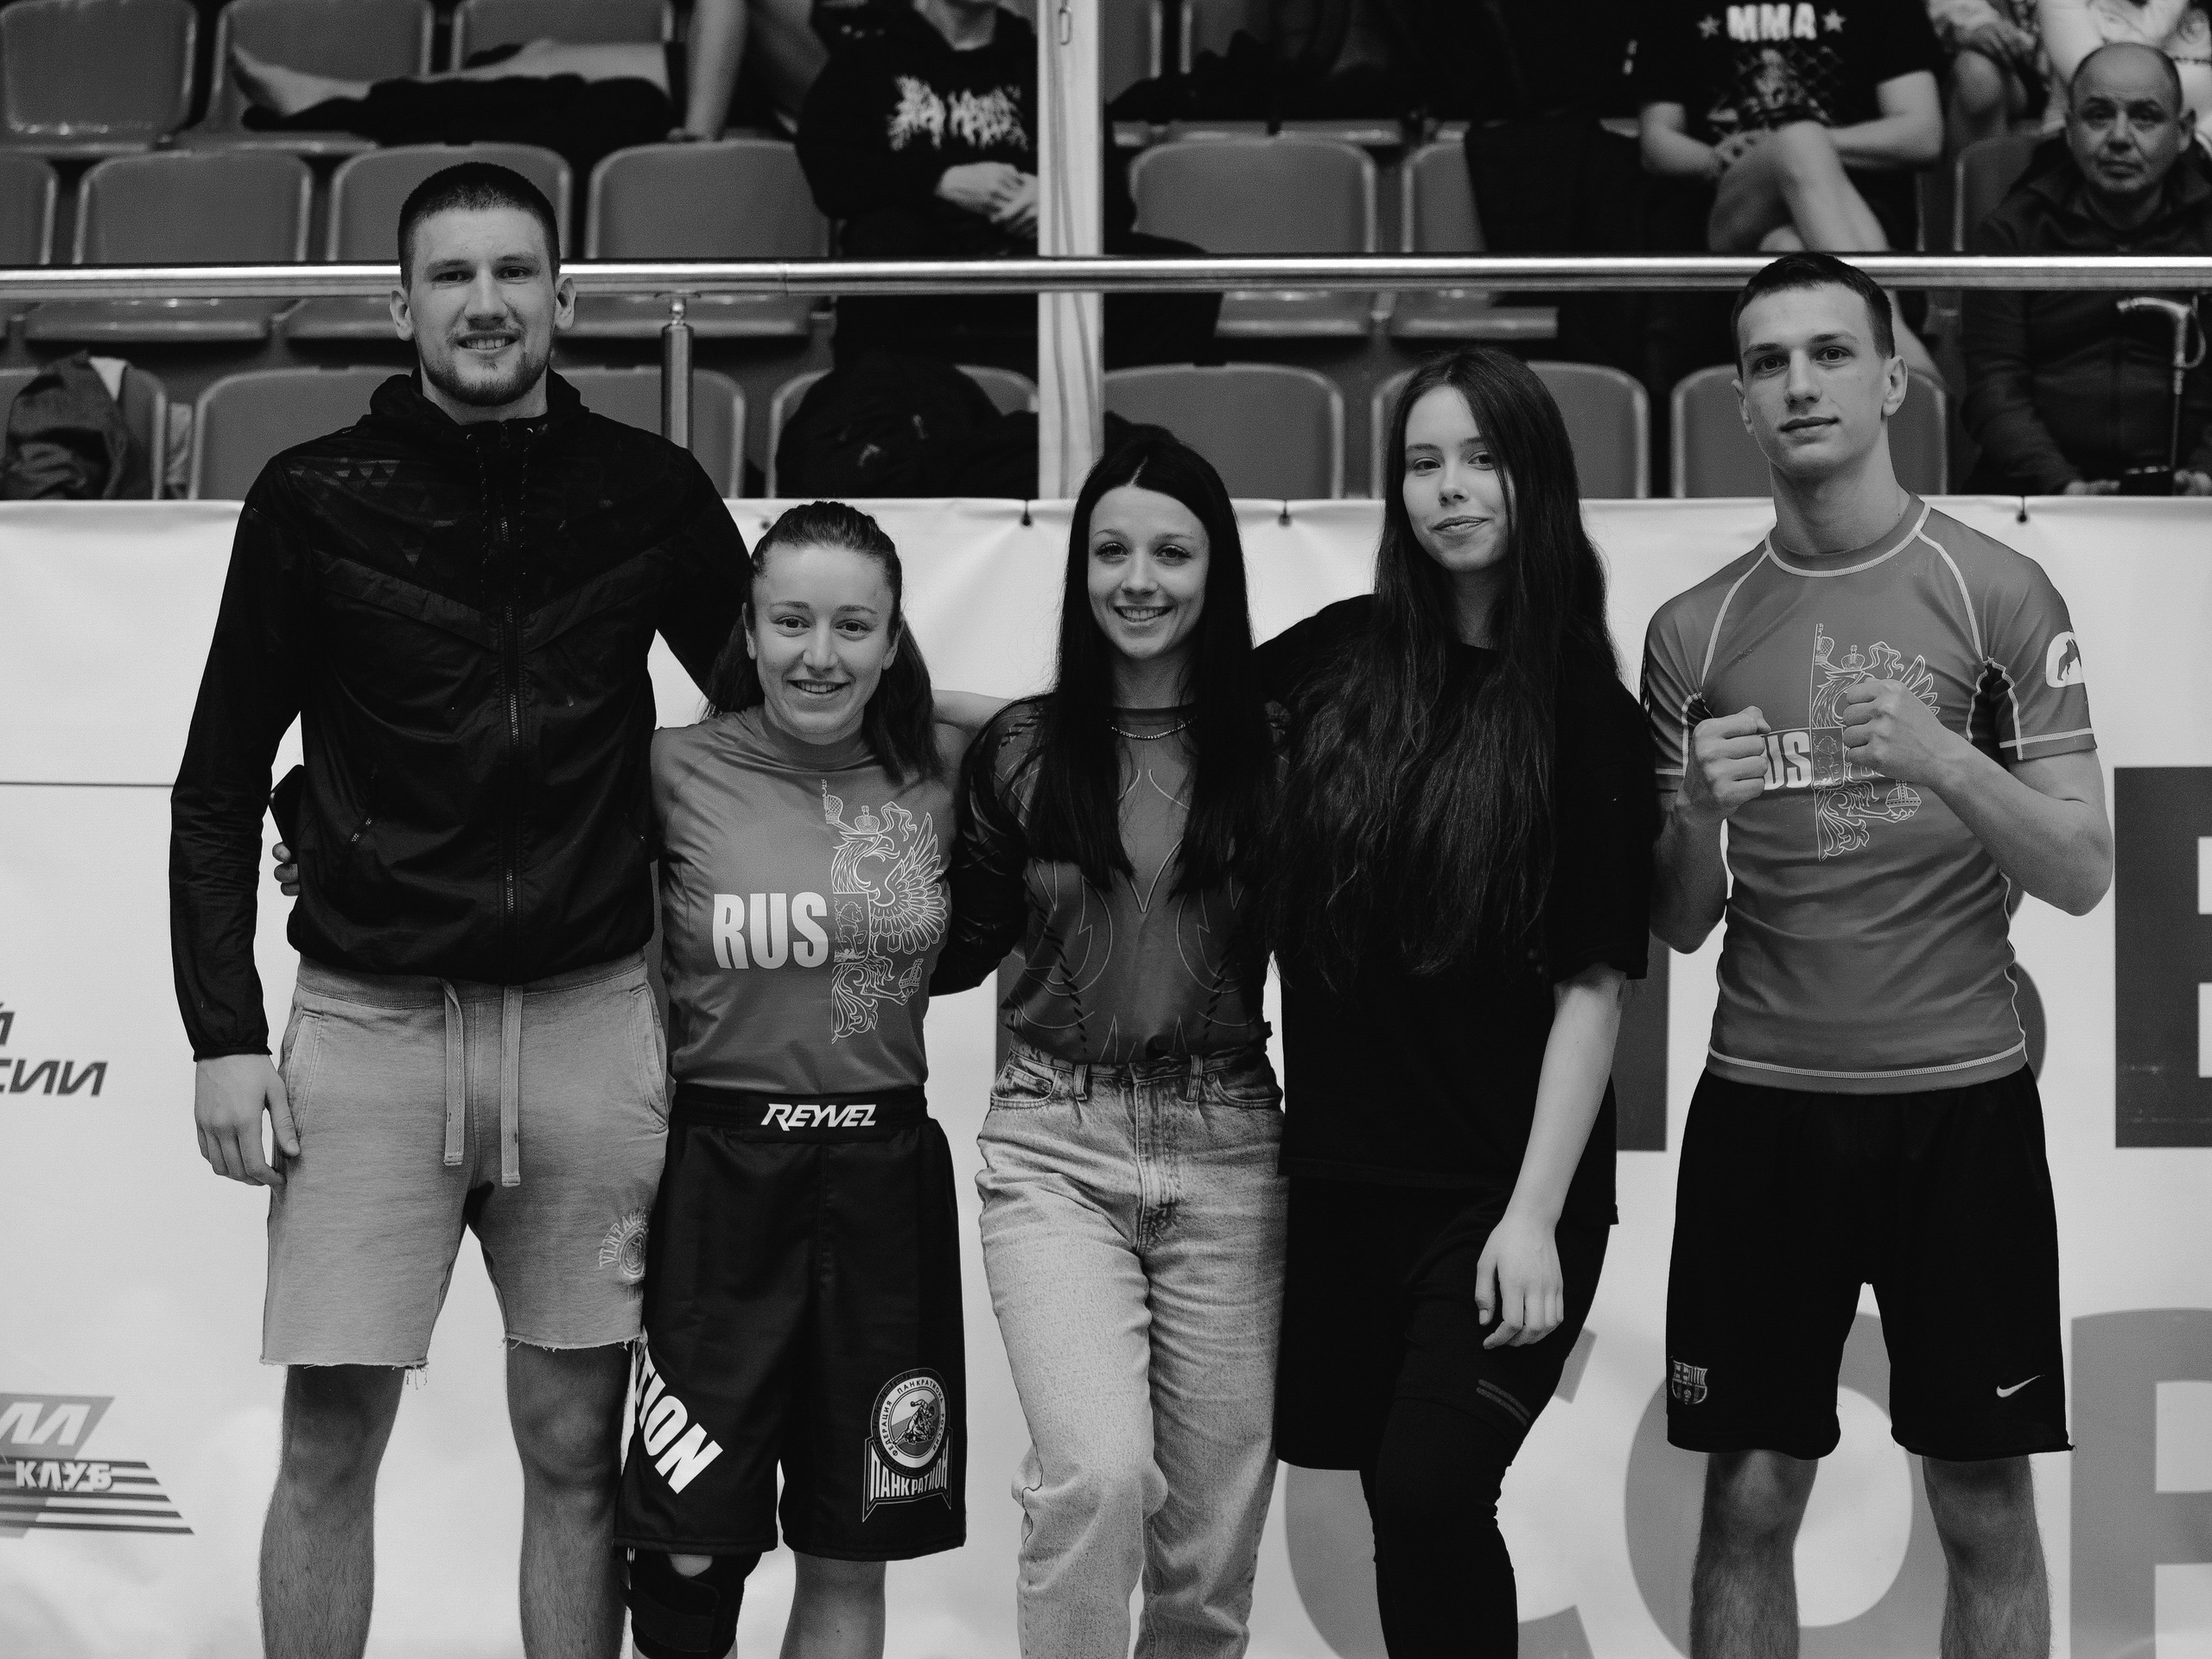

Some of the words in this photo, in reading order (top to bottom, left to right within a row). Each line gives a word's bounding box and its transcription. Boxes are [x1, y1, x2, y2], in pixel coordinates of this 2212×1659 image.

[1726, 3, 1817, 42] MMA
[1764, 731, 1813, 791] US
[712, 892, 829, 969] RUS
[636, 1325, 724, 1495] TION
[881, 1400, 899, 1457] ФЕДЕРАЦИЯ
[897, 1379, 944, 1403] ПАНКРАТИОНА
[15, 1459, 112, 1492] КЛУБ
[869, 1435, 950, 1503] ПАНКРАТИОН
